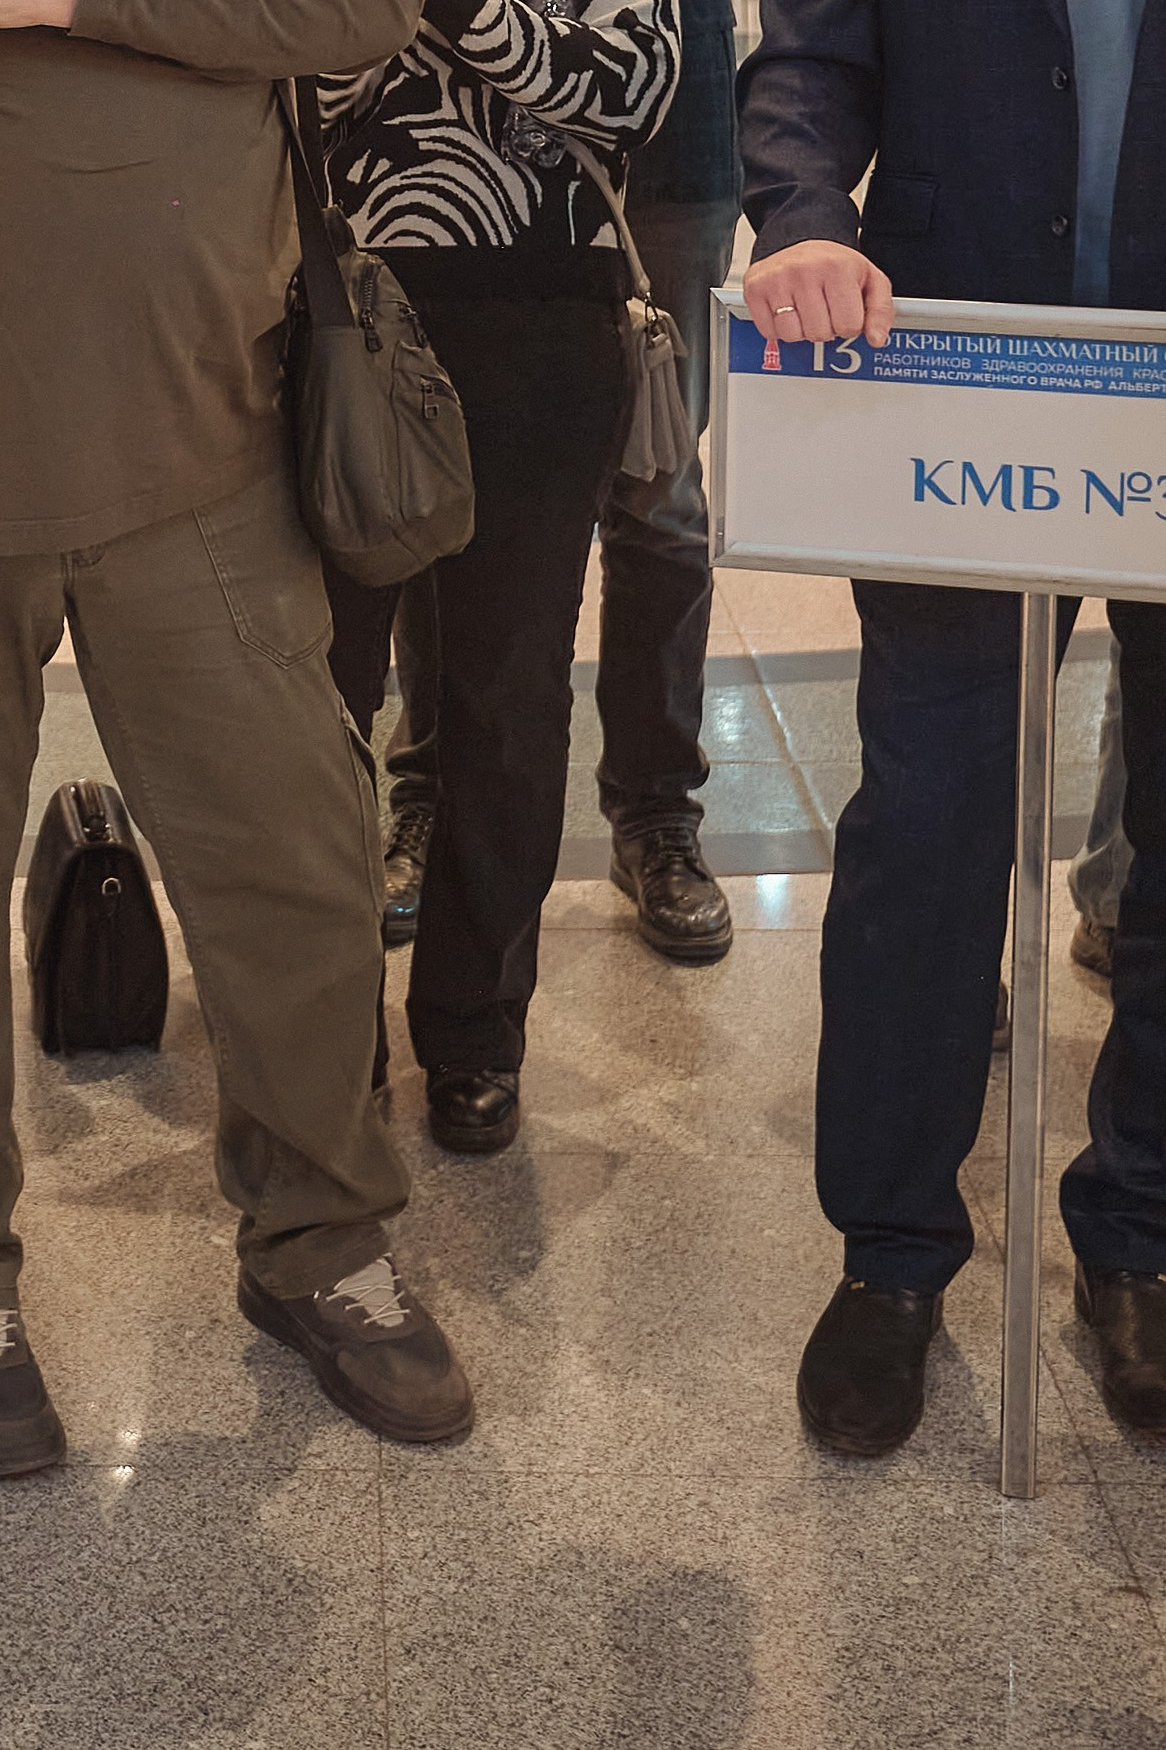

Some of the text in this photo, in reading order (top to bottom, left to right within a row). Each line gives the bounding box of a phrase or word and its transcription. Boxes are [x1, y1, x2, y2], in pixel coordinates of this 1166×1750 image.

[813, 335, 862, 374] 13
[1008, 338, 1158, 364] ШАХМАТНЫЙ
[874, 353, 971, 369] РАБОТНИКОВ
[981, 358, 1123, 377] ЗДРАВООХРАНЕНИЯ
[874, 366, 928, 379] ПАМЯТИ
[931, 369, 1038, 385] ЗАСЛУЖЕННОГО
[1040, 376, 1082, 389] ВРАЧА
[1085, 380, 1103, 389] РФ
[910, 457, 1061, 512] КМБ
